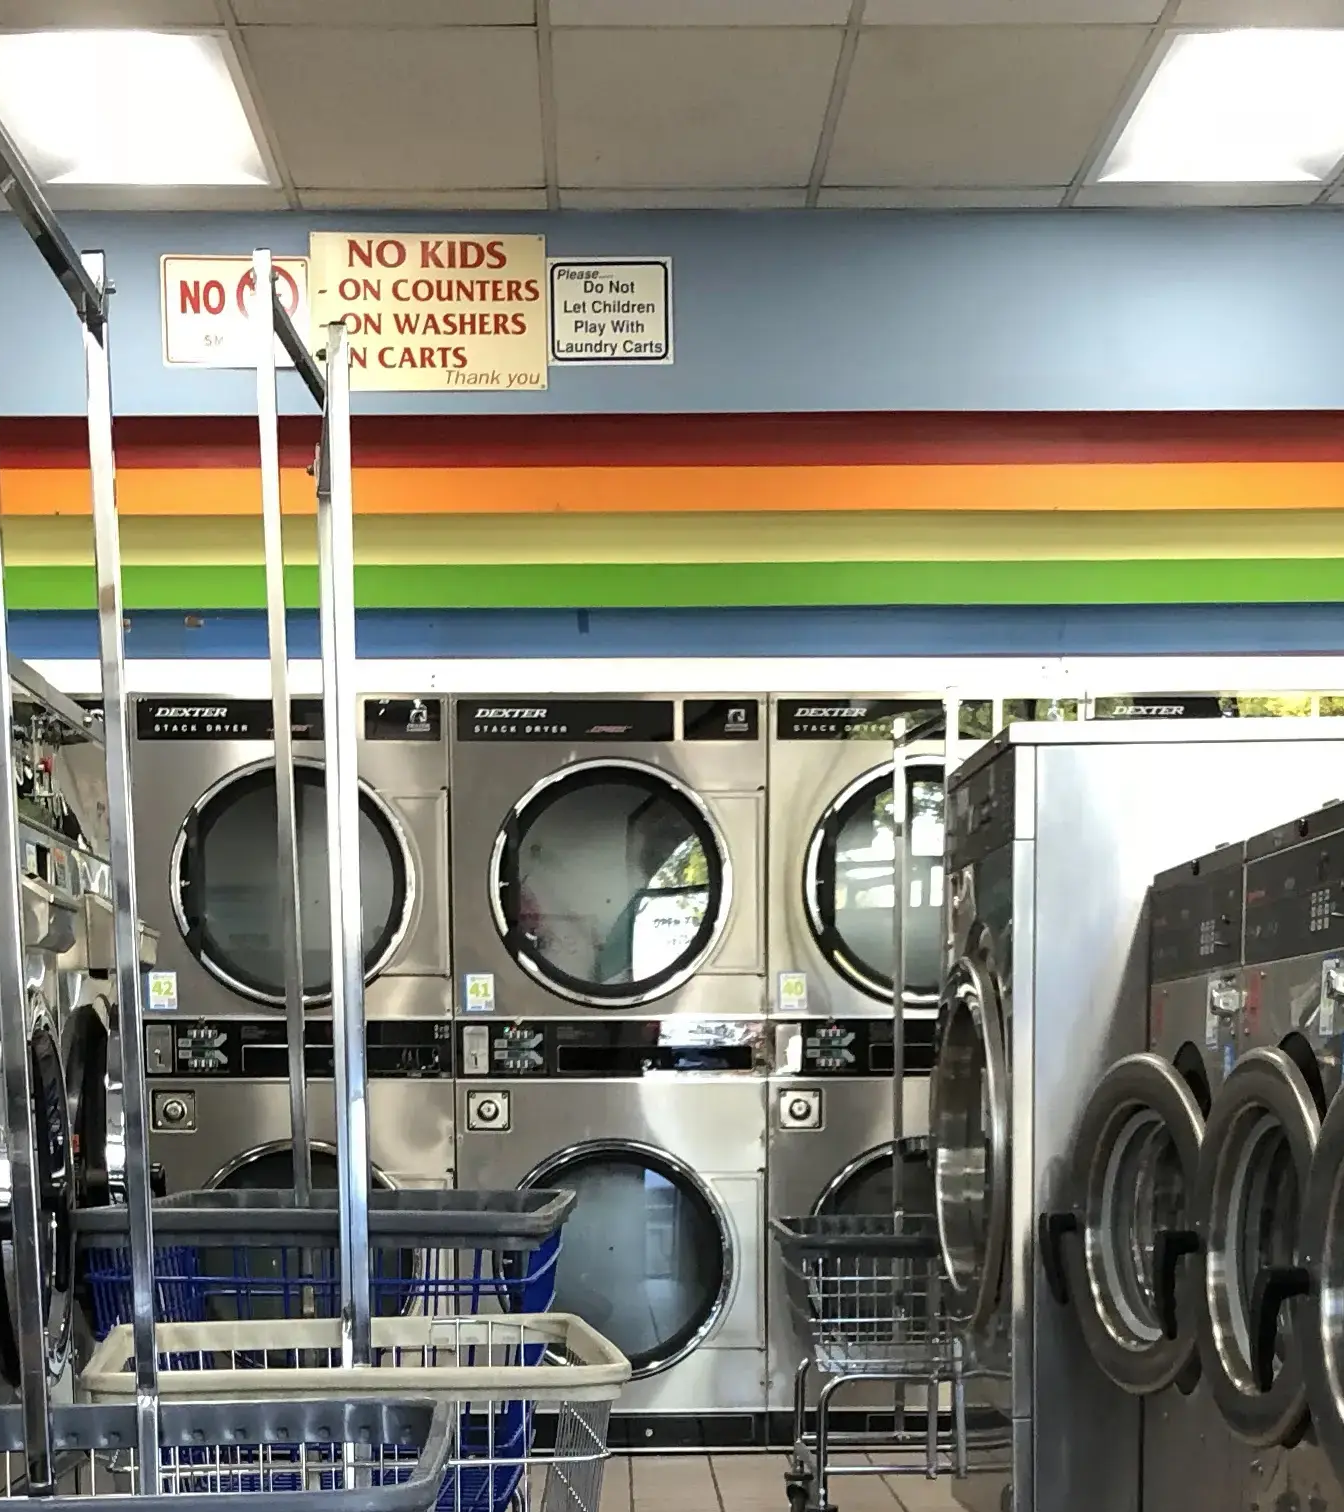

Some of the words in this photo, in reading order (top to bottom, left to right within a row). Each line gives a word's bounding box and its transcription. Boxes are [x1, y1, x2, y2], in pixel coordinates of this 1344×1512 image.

[347, 239, 408, 270] NO
[420, 239, 508, 271] KIDS
[339, 279, 385, 302] ON
[391, 278, 540, 303] COUNTERS
[583, 279, 607, 295] Do
[610, 279, 636, 295] Not
[180, 279, 226, 315] NO
[563, 299, 586, 315] Let
[591, 299, 656, 315] Children
[341, 312, 384, 336] ON
[394, 312, 528, 337] WASHERS
[574, 319, 602, 336] Play
[606, 319, 646, 335] With
[557, 338, 618, 356] Laundry
[622, 338, 664, 355] Carts
[378, 347, 469, 370] CARTS
[445, 368, 502, 386] Thank
[507, 371, 541, 389] you
[155, 707, 228, 718] DEXTER
[475, 708, 547, 719] DEXTER
[794, 707, 867, 718] DEXTER
[1113, 705, 1185, 716] DEXTER
[474, 725, 517, 733] STACK
[525, 725, 568, 733] DRYER
[152, 981, 174, 997] 42
[469, 983, 490, 998] 41
[781, 981, 805, 998] 40
